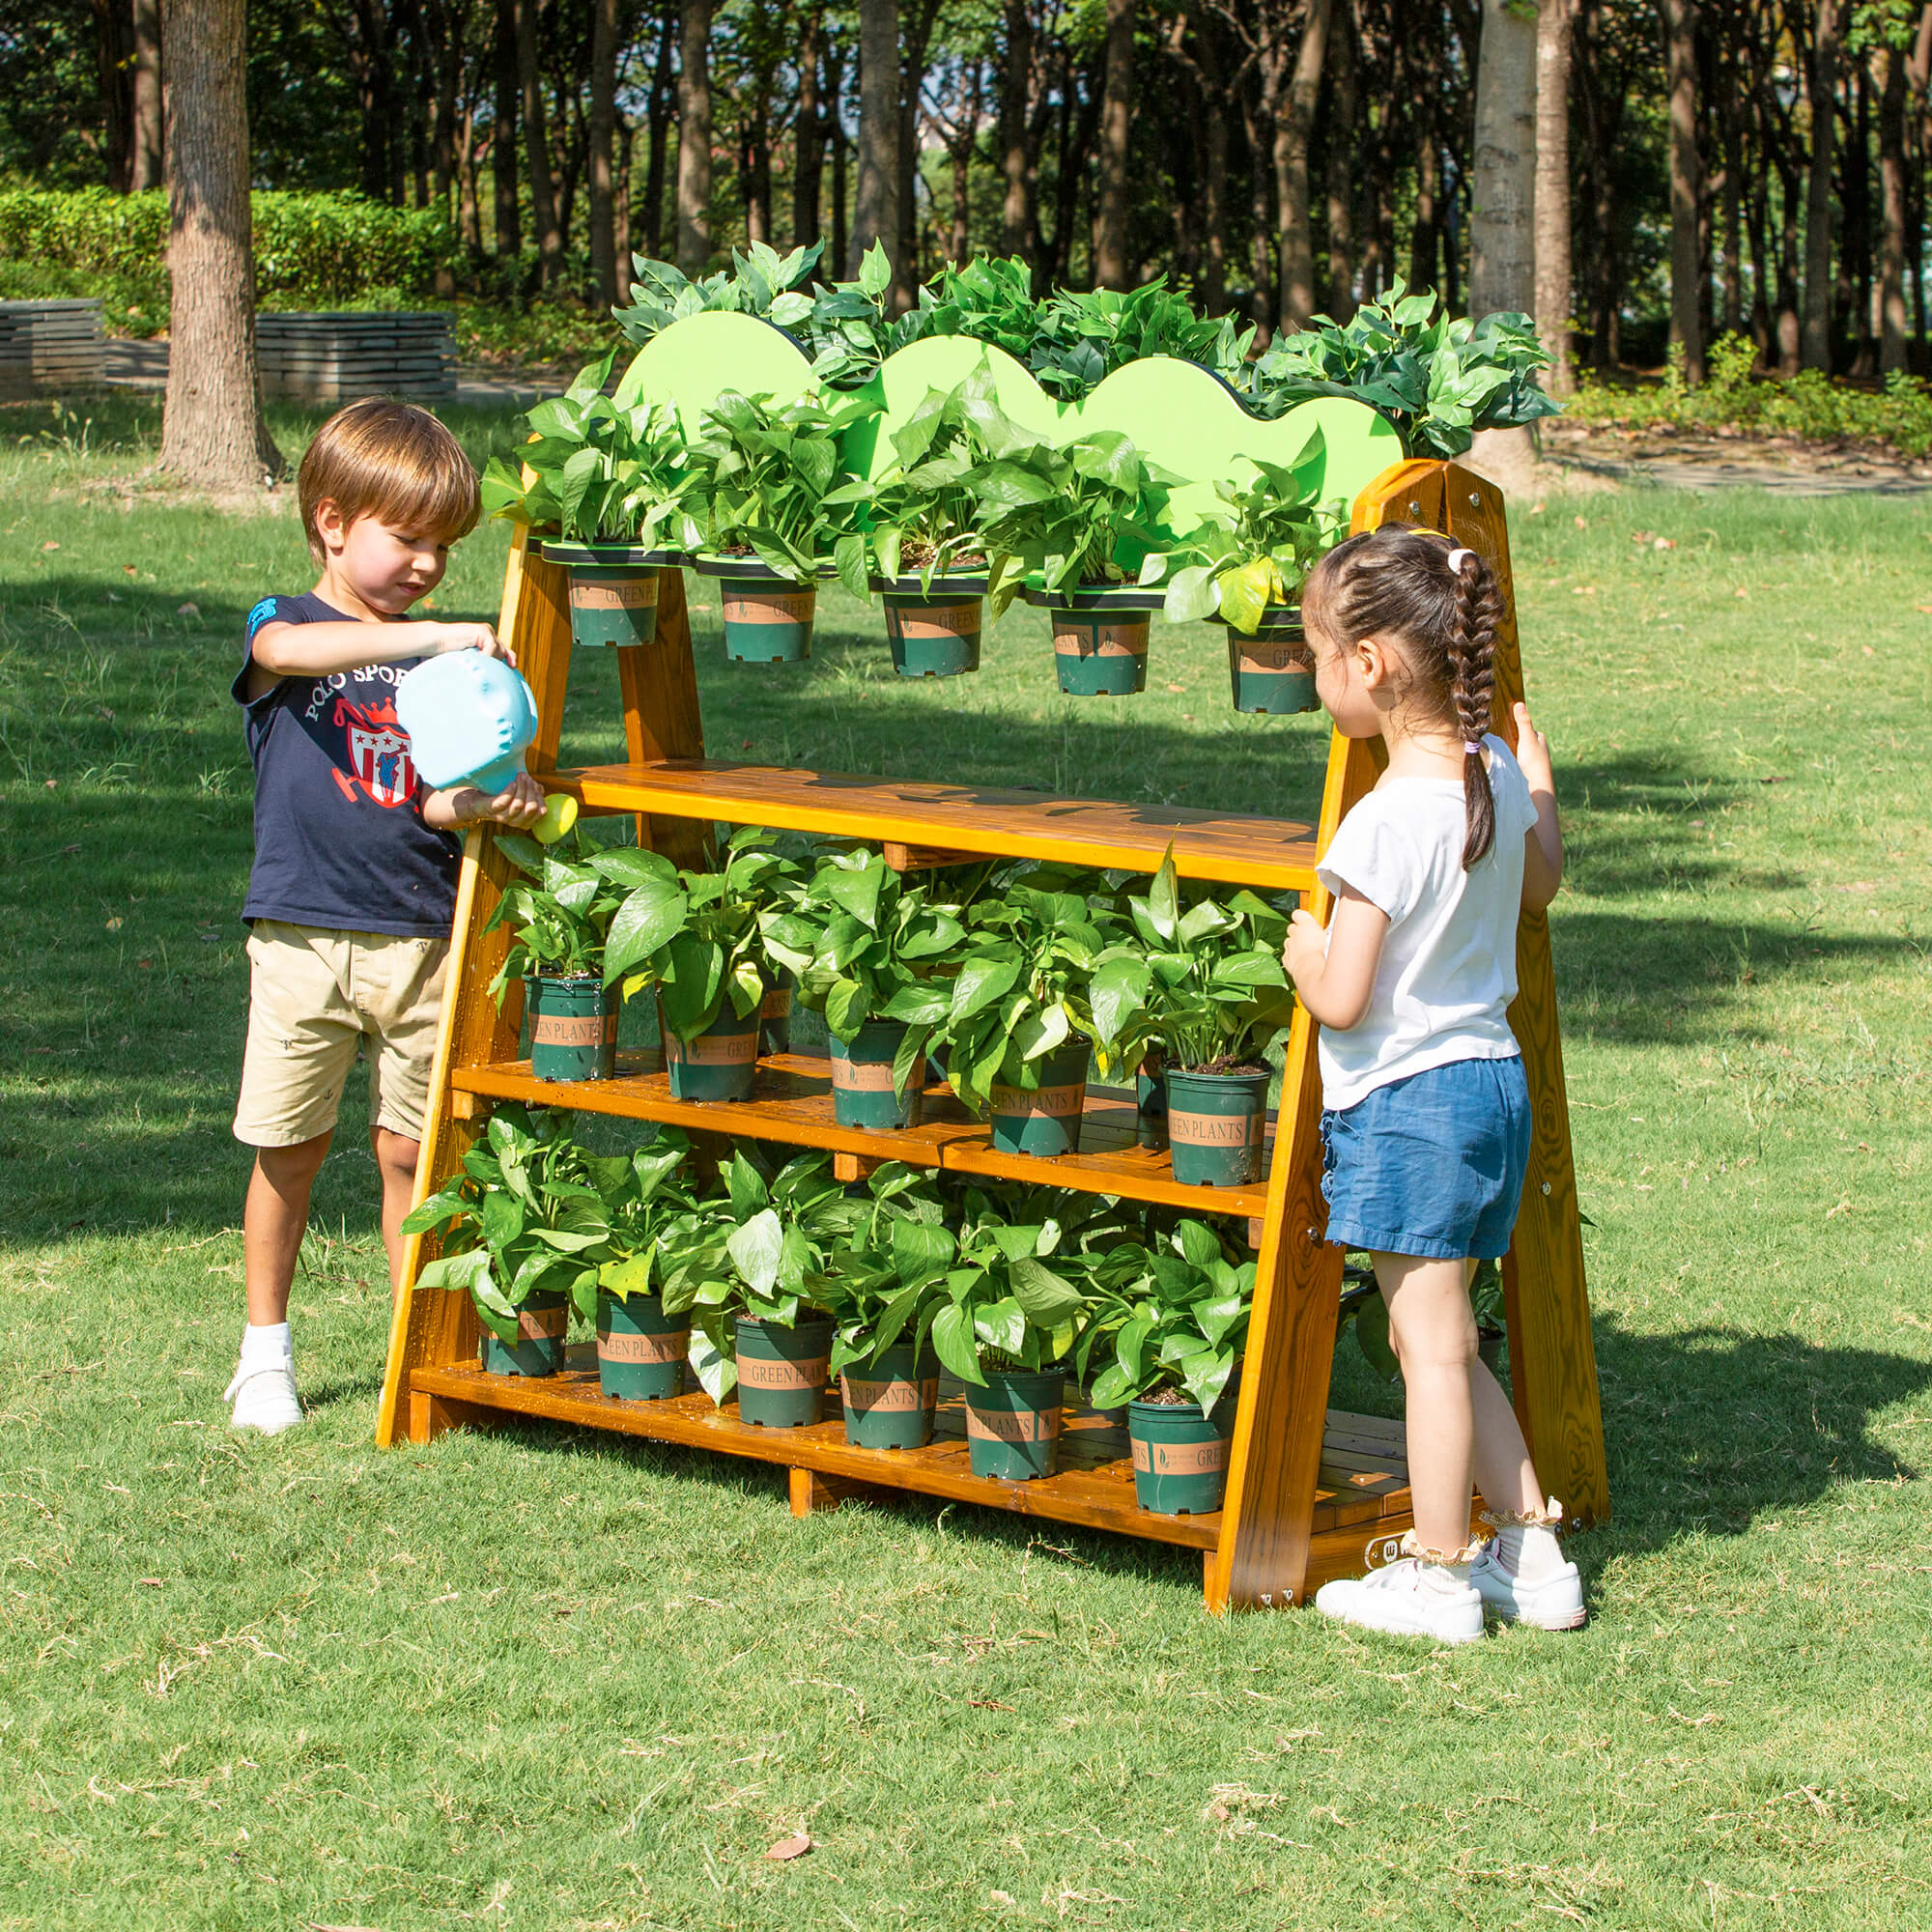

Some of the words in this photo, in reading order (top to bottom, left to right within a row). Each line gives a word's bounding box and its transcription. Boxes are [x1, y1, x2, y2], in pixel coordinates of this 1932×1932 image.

[305, 672, 347, 722] POLO
[1019, 1093, 1067, 1111] PLANTS
[1192, 1120, 1243, 1140] PLANTS
[752, 1365, 792, 1383] GREEN
[866, 1386, 915, 1406] PLANTS
[981, 1414, 1031, 1436] PLANTS
